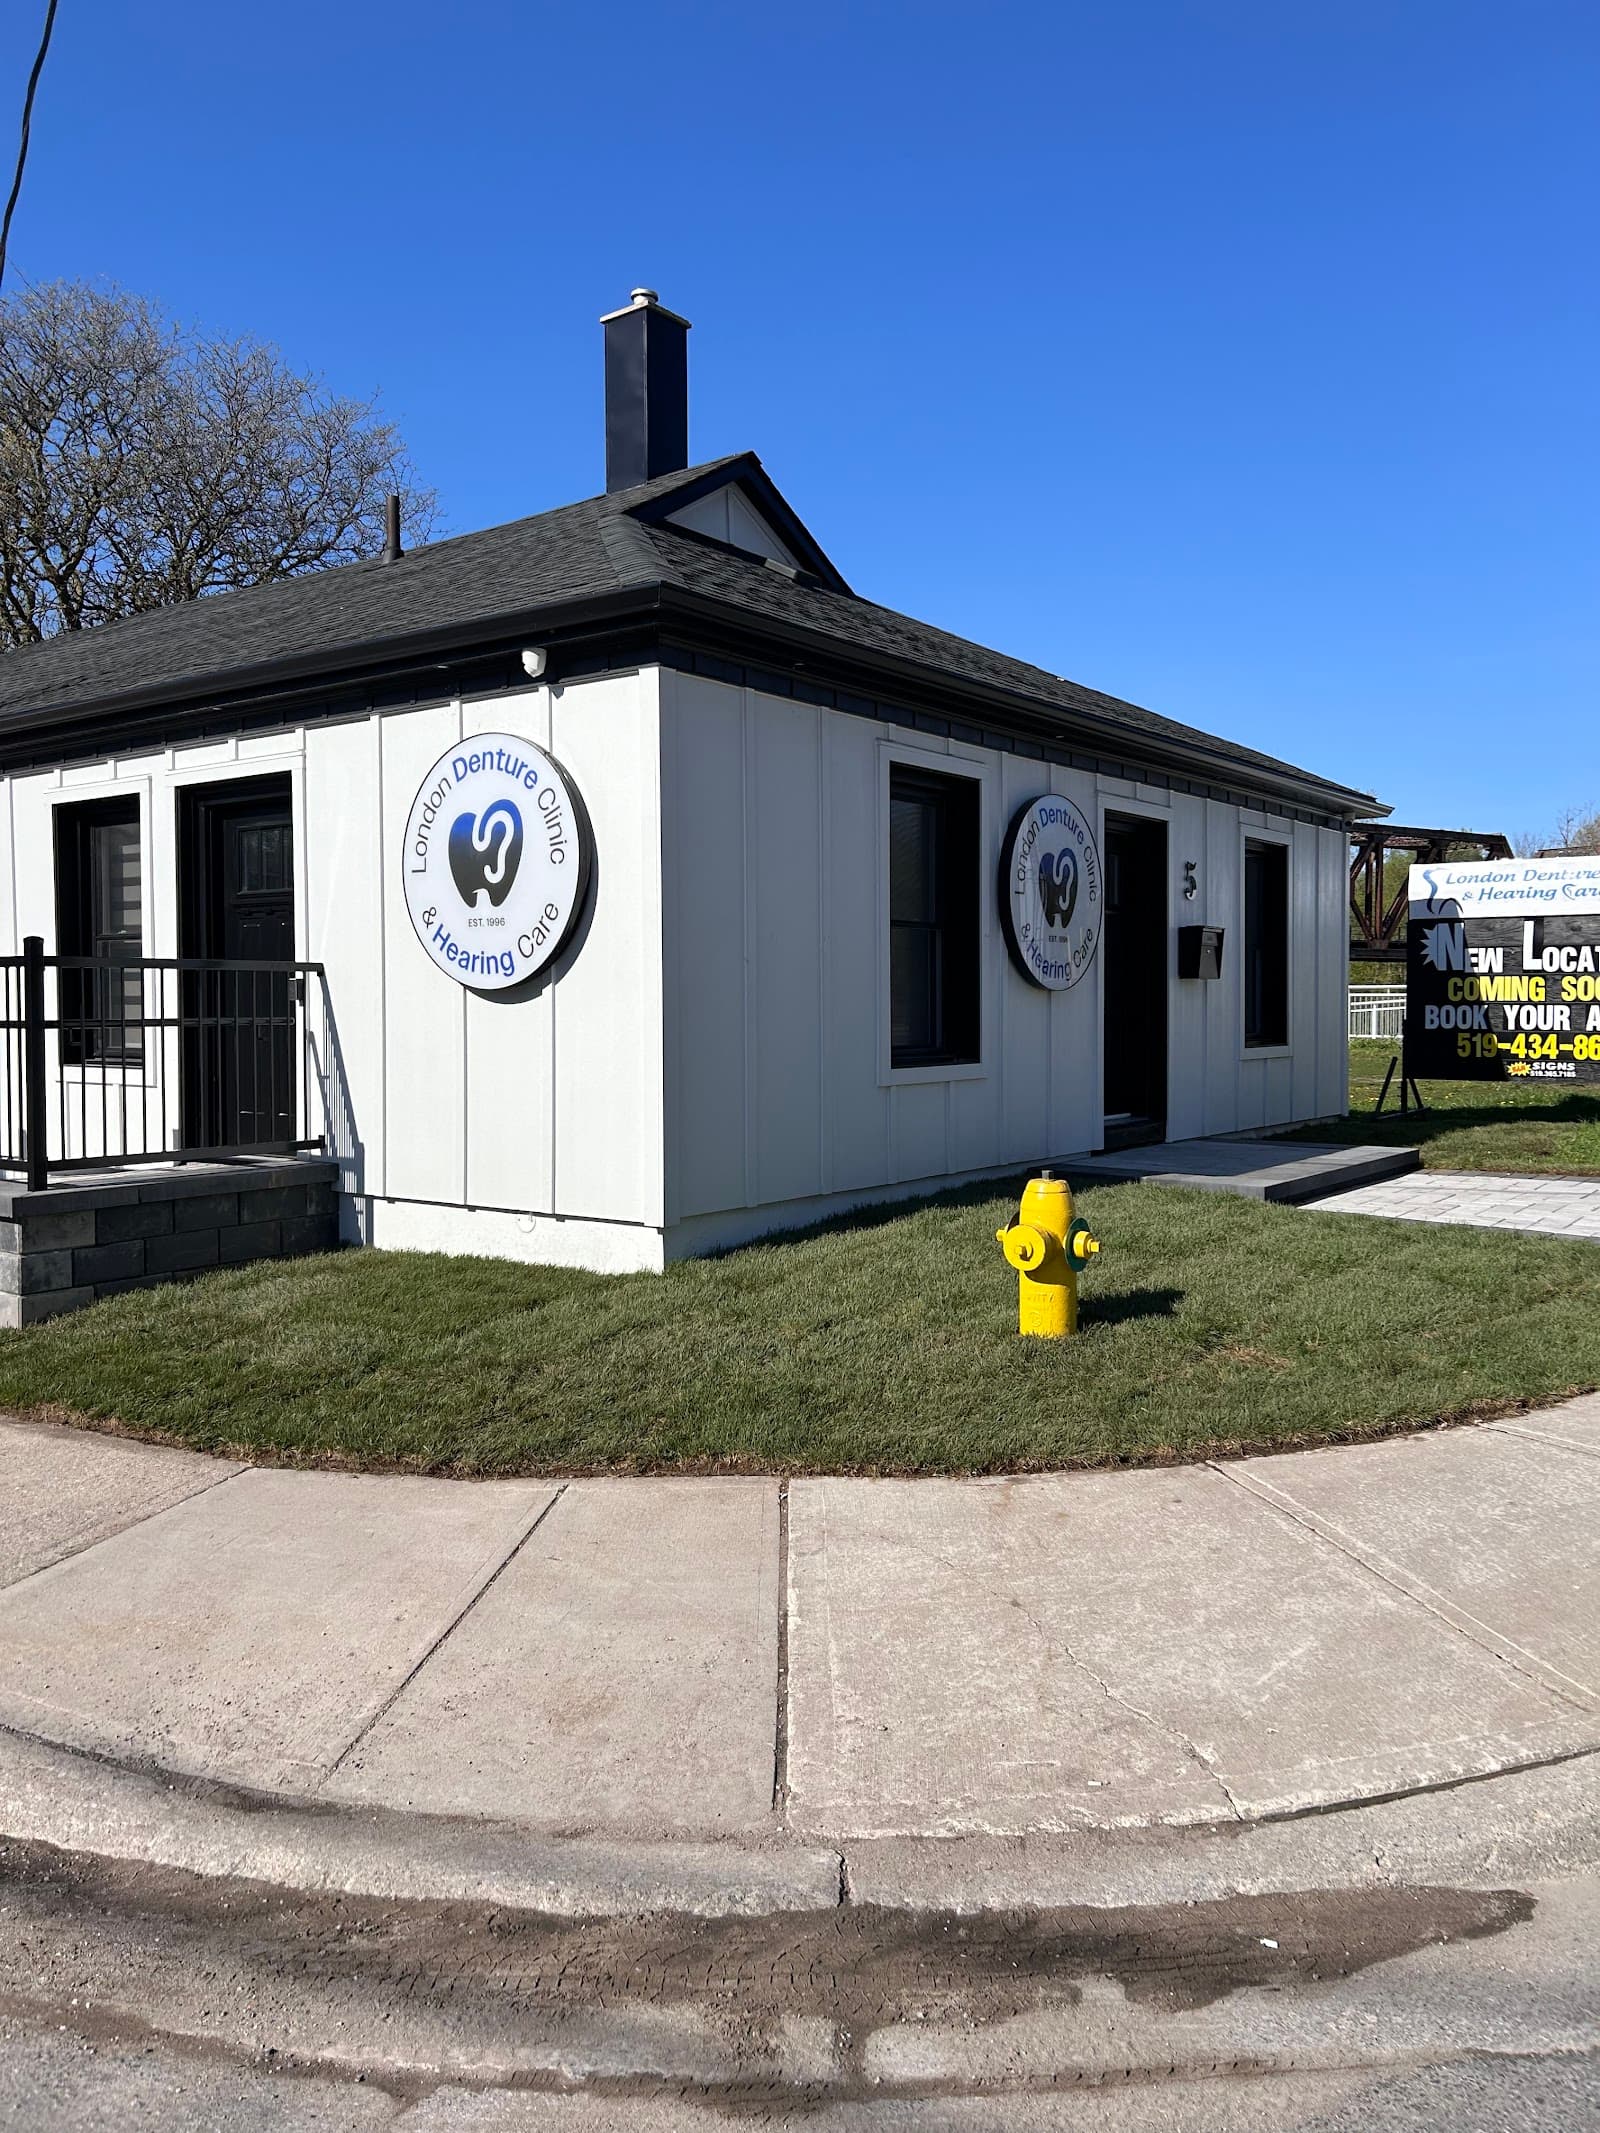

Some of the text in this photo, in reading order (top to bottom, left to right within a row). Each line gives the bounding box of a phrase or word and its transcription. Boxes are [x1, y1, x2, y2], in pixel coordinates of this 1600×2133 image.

[411, 748, 565, 874] London Denture Clinic
[1015, 807, 1097, 903] London Denture Clinic
[1446, 872, 1516, 885] London
[1462, 884, 1600, 901] & Hearing Car
[468, 918, 506, 928] EST. 1996
[422, 902, 559, 977] & Hearing Care
[1021, 923, 1093, 982] & Hearing Care
[1437, 923, 1504, 974] NEW
[1447, 976, 1600, 1002] COMING SO
[1424, 1004, 1489, 1030] BOOK
[1502, 1004, 1571, 1031] YOUR
[1456, 1032, 1600, 1060] 519-434-86
[1532, 1062, 1576, 1071] SIGNS
